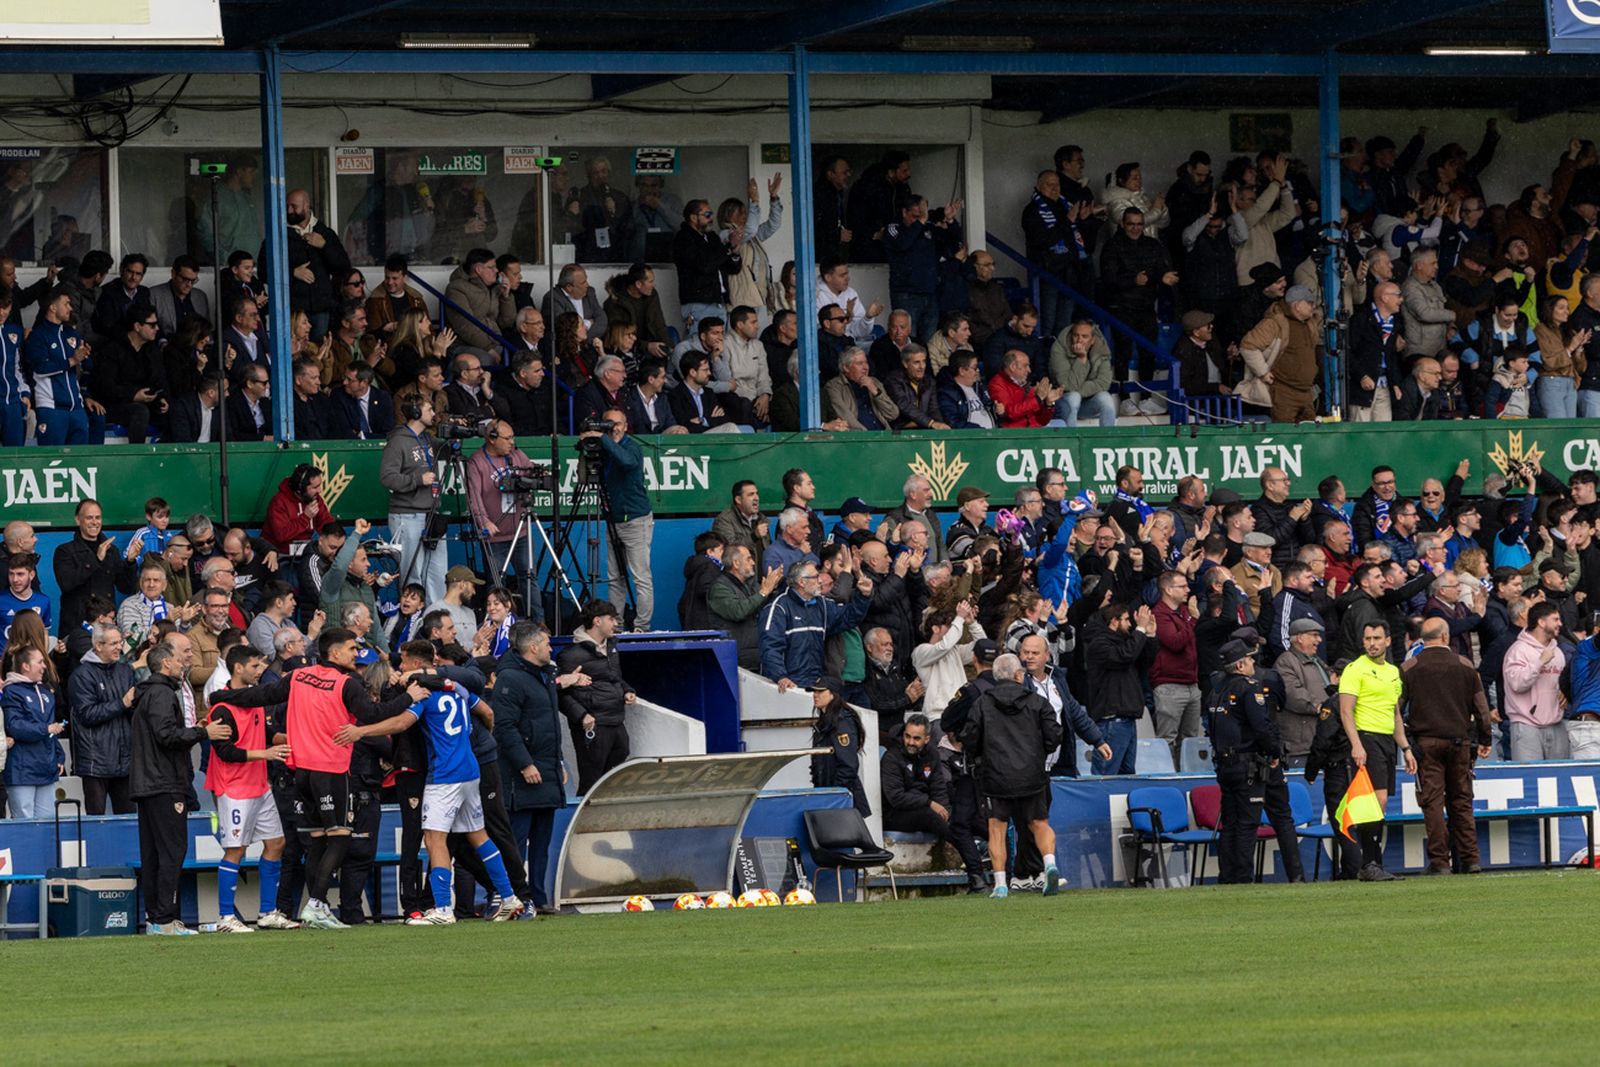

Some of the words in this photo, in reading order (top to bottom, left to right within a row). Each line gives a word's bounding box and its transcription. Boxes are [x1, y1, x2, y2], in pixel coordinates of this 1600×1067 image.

[643, 449, 710, 490] AÉN
[1093, 447, 1209, 481] RURAL
[1220, 438, 1303, 481] JAÉN
[2, 459, 97, 507] JAÉN
[438, 693, 468, 736] 21
[231, 809, 241, 825] 6
[747, 859, 758, 884] TEAM
